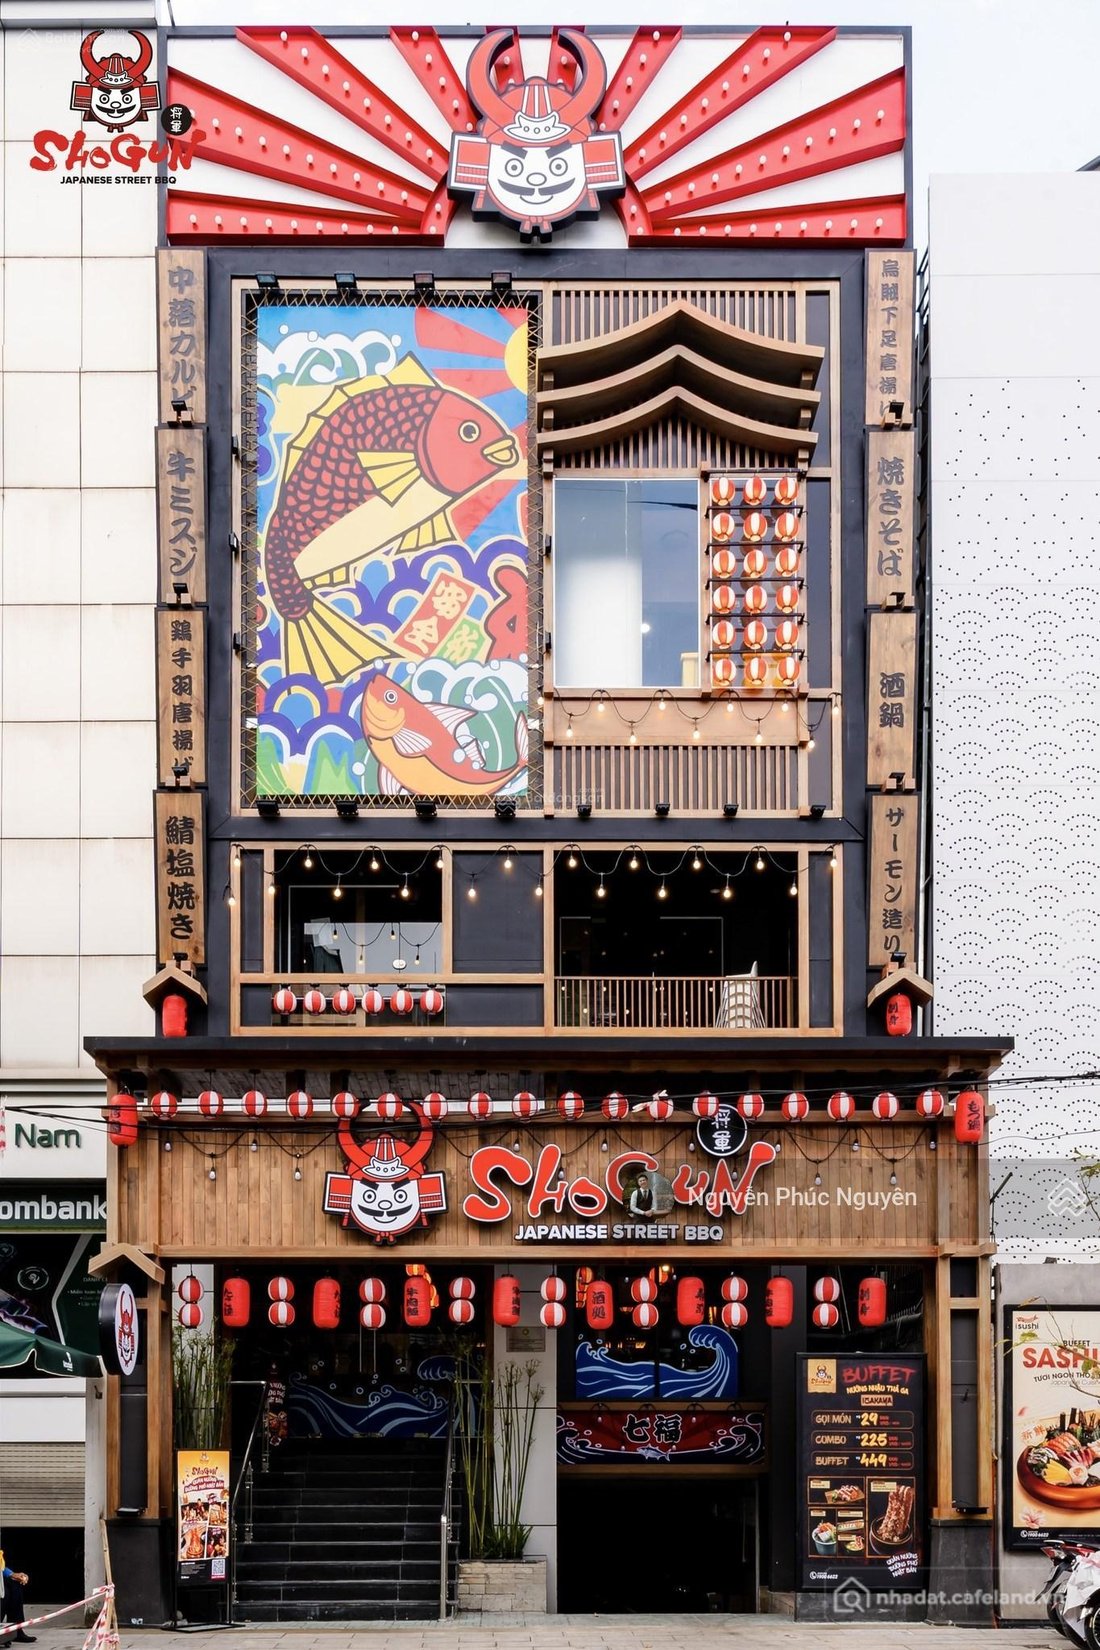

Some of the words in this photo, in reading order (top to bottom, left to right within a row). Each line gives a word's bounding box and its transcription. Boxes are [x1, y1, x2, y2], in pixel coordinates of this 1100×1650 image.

[167, 452, 197, 576] 牛ミスジ
[877, 457, 905, 576] 焼きそば
[879, 672, 906, 728] 酒鍋
[166, 816, 195, 940] 鯖塩焼き
[883, 807, 904, 953] サーモン造り
[15, 1123, 81, 1148] Nam
[515, 1224, 607, 1240] JAPANESE
[612, 1224, 679, 1240] STREET
[684, 1226, 723, 1241] BBQ
[843, 1364, 917, 1384] BUFFET
[622, 1414, 682, 1443] 七福
[815, 1415, 830, 1426] GỌI
[832, 1413, 851, 1424] MÓN
[861, 1412, 878, 1426] 29
[815, 1435, 847, 1445] COMBO
[861, 1433, 887, 1446] 225
[815, 1456, 849, 1466] BUFFET
[860, 1453, 887, 1467] 449
